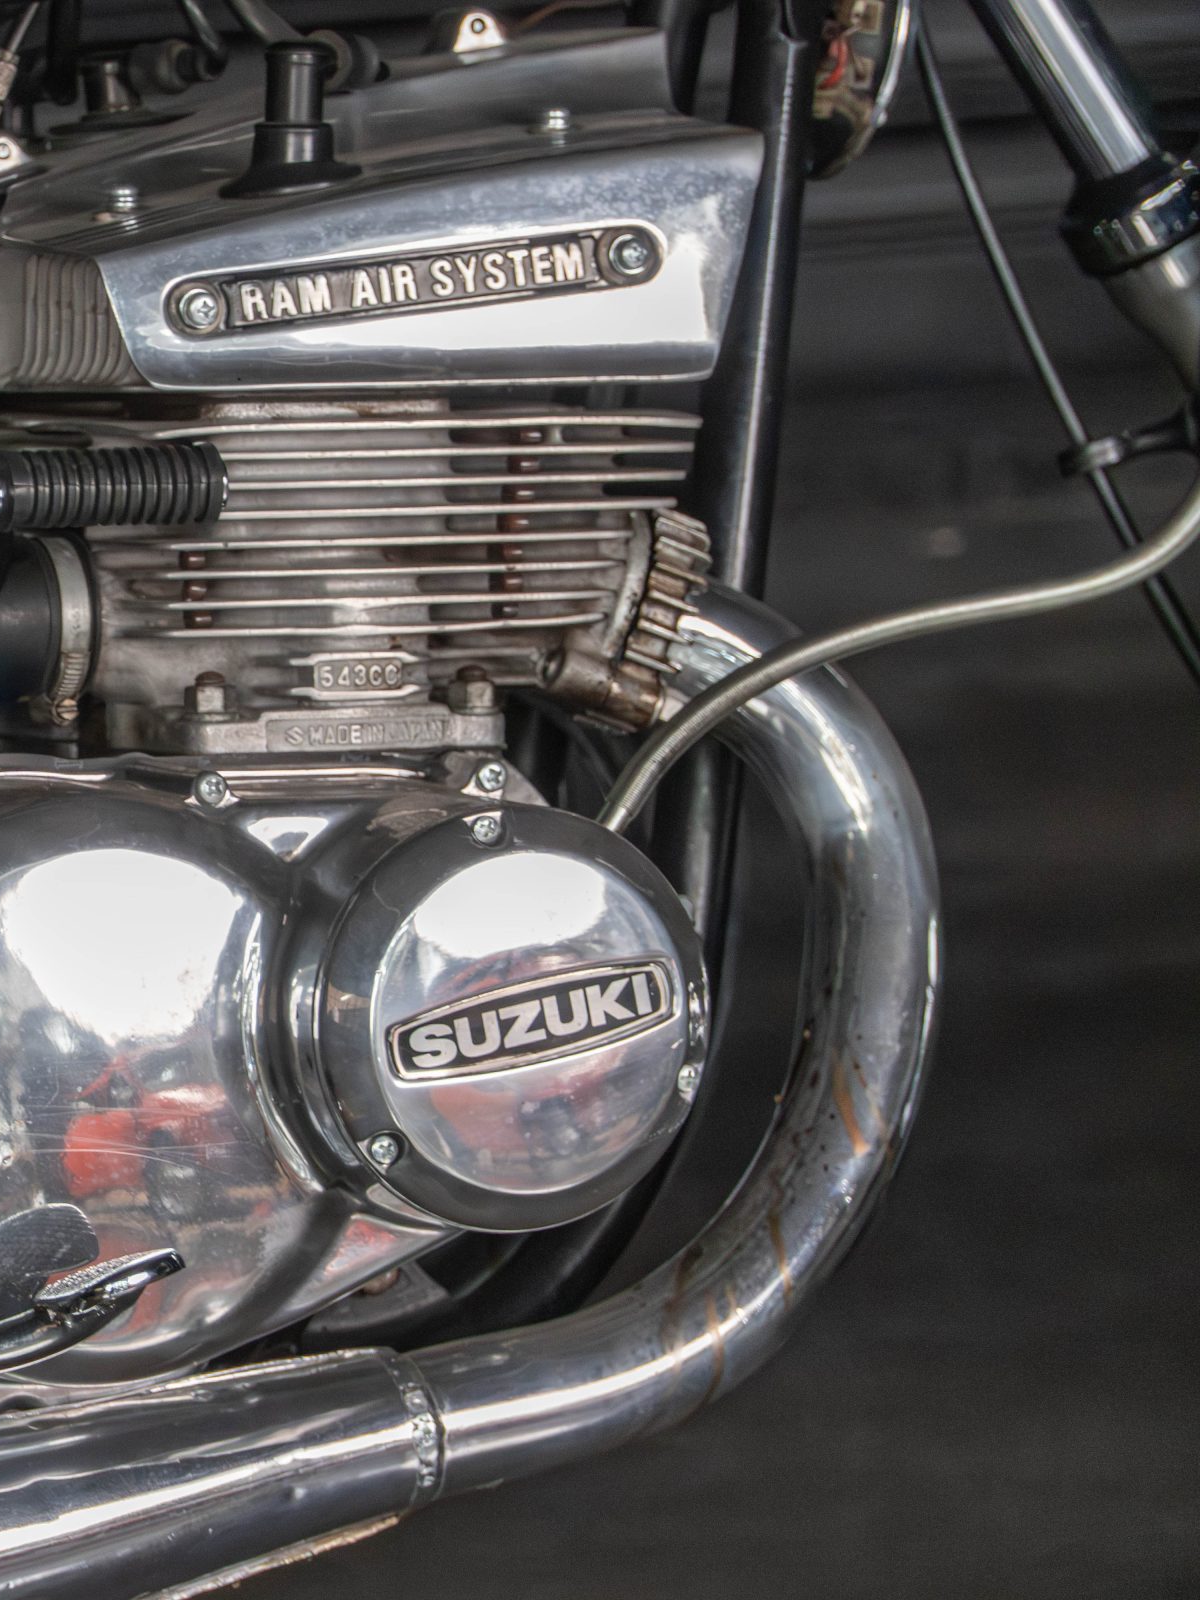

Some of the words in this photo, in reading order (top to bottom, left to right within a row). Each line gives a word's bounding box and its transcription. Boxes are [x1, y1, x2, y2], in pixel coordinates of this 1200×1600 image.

[240, 275, 332, 321] RAM
[351, 264, 419, 308] AIR
[429, 242, 586, 297] SYSTEM
[319, 663, 399, 688] 543CC
[309, 723, 363, 746] MADE
[364, 722, 385, 744] IN
[408, 972, 653, 1069] SUZUKI
